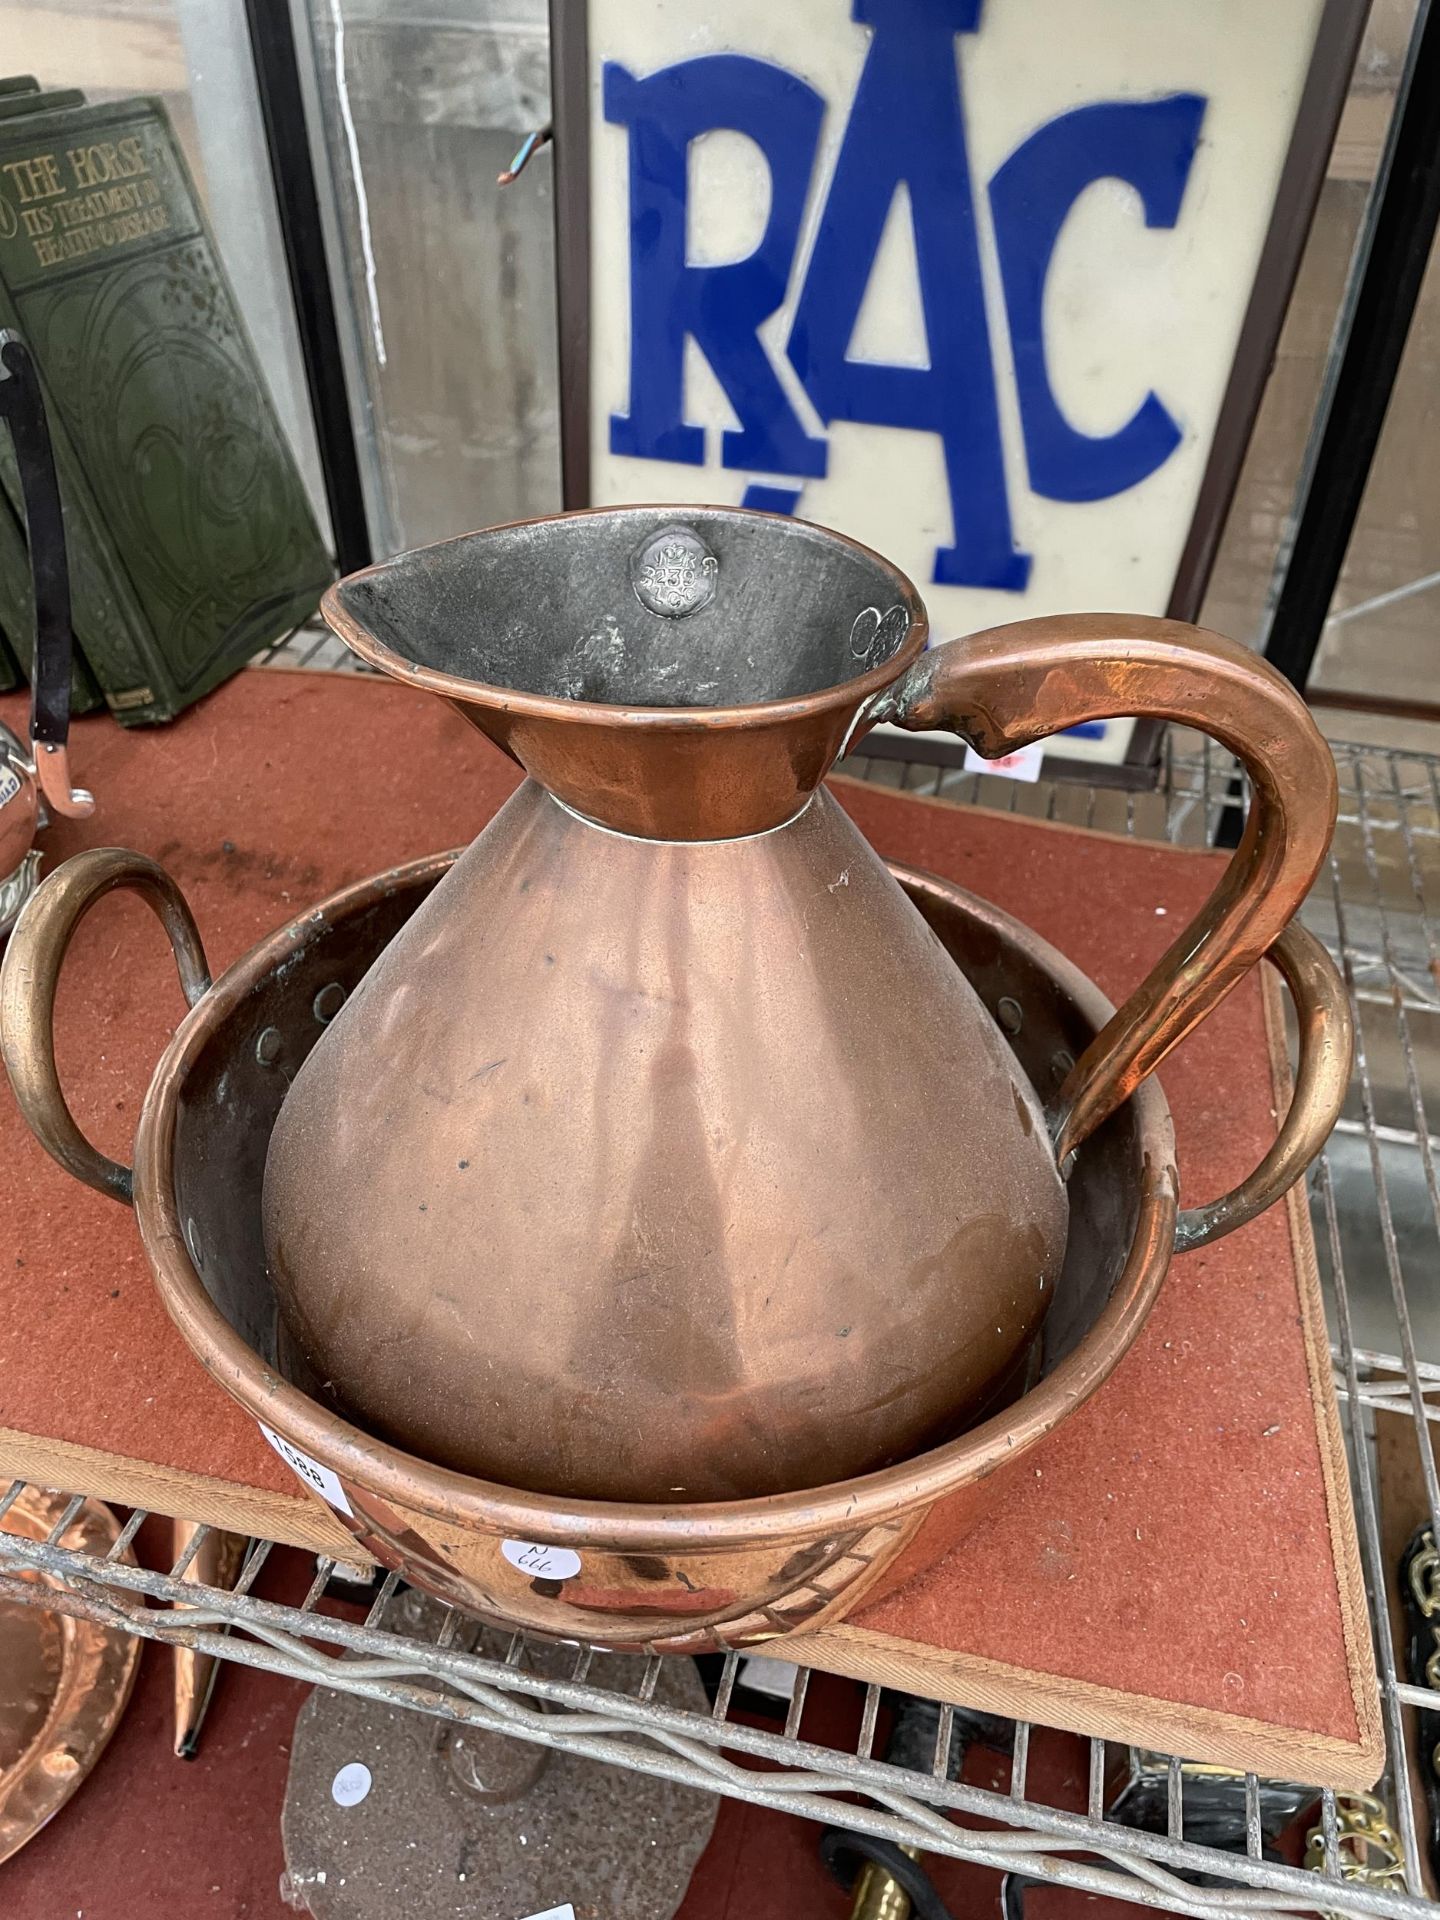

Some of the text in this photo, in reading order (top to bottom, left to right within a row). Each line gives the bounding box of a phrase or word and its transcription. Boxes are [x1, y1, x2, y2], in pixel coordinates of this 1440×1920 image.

[3, 137, 151, 203] THE HORSE
[20, 206, 54, 236] ITS
[54, 182, 144, 227] TREATMENT
[603, 0, 1208, 592] RAC
[272, 1434, 325, 1489] 1588
